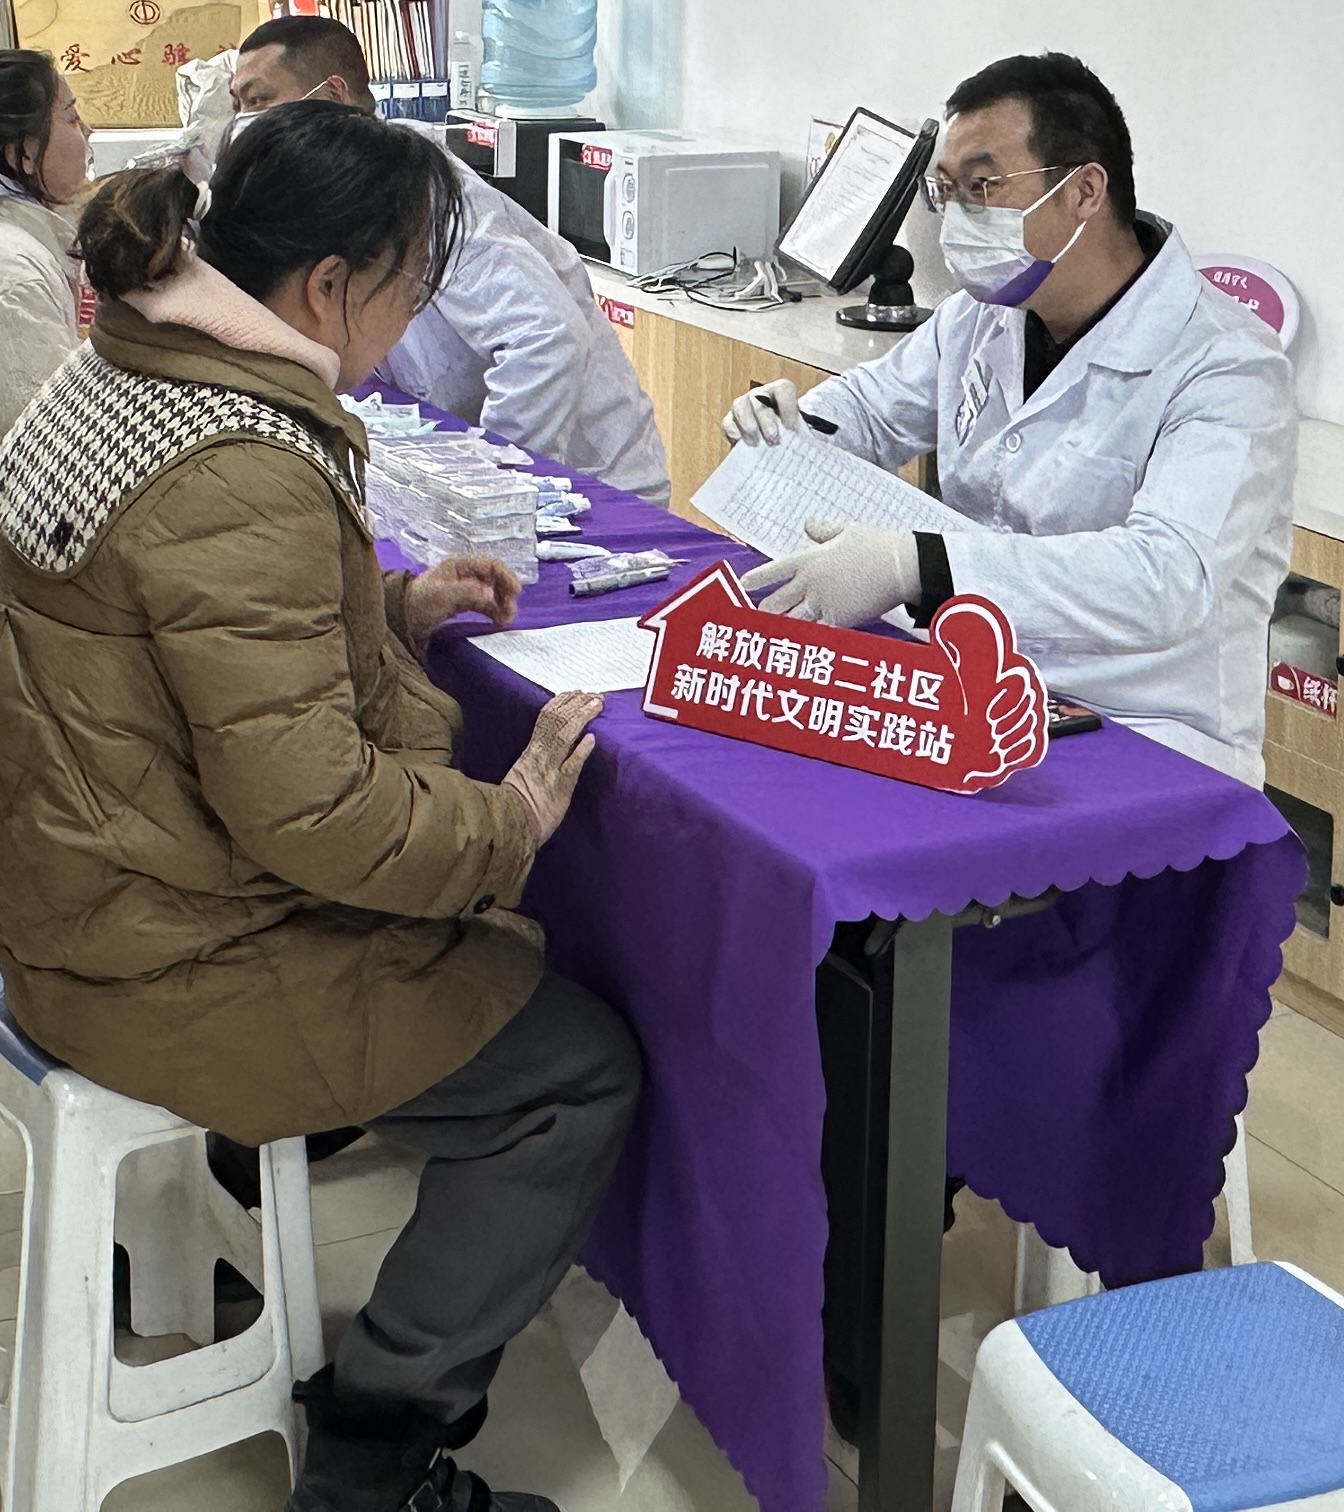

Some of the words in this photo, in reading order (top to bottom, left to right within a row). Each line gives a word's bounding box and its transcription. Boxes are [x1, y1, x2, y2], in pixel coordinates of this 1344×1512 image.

[696, 621, 945, 711] 解放南路二社区
[670, 664, 955, 765] 新时代文明实践站
